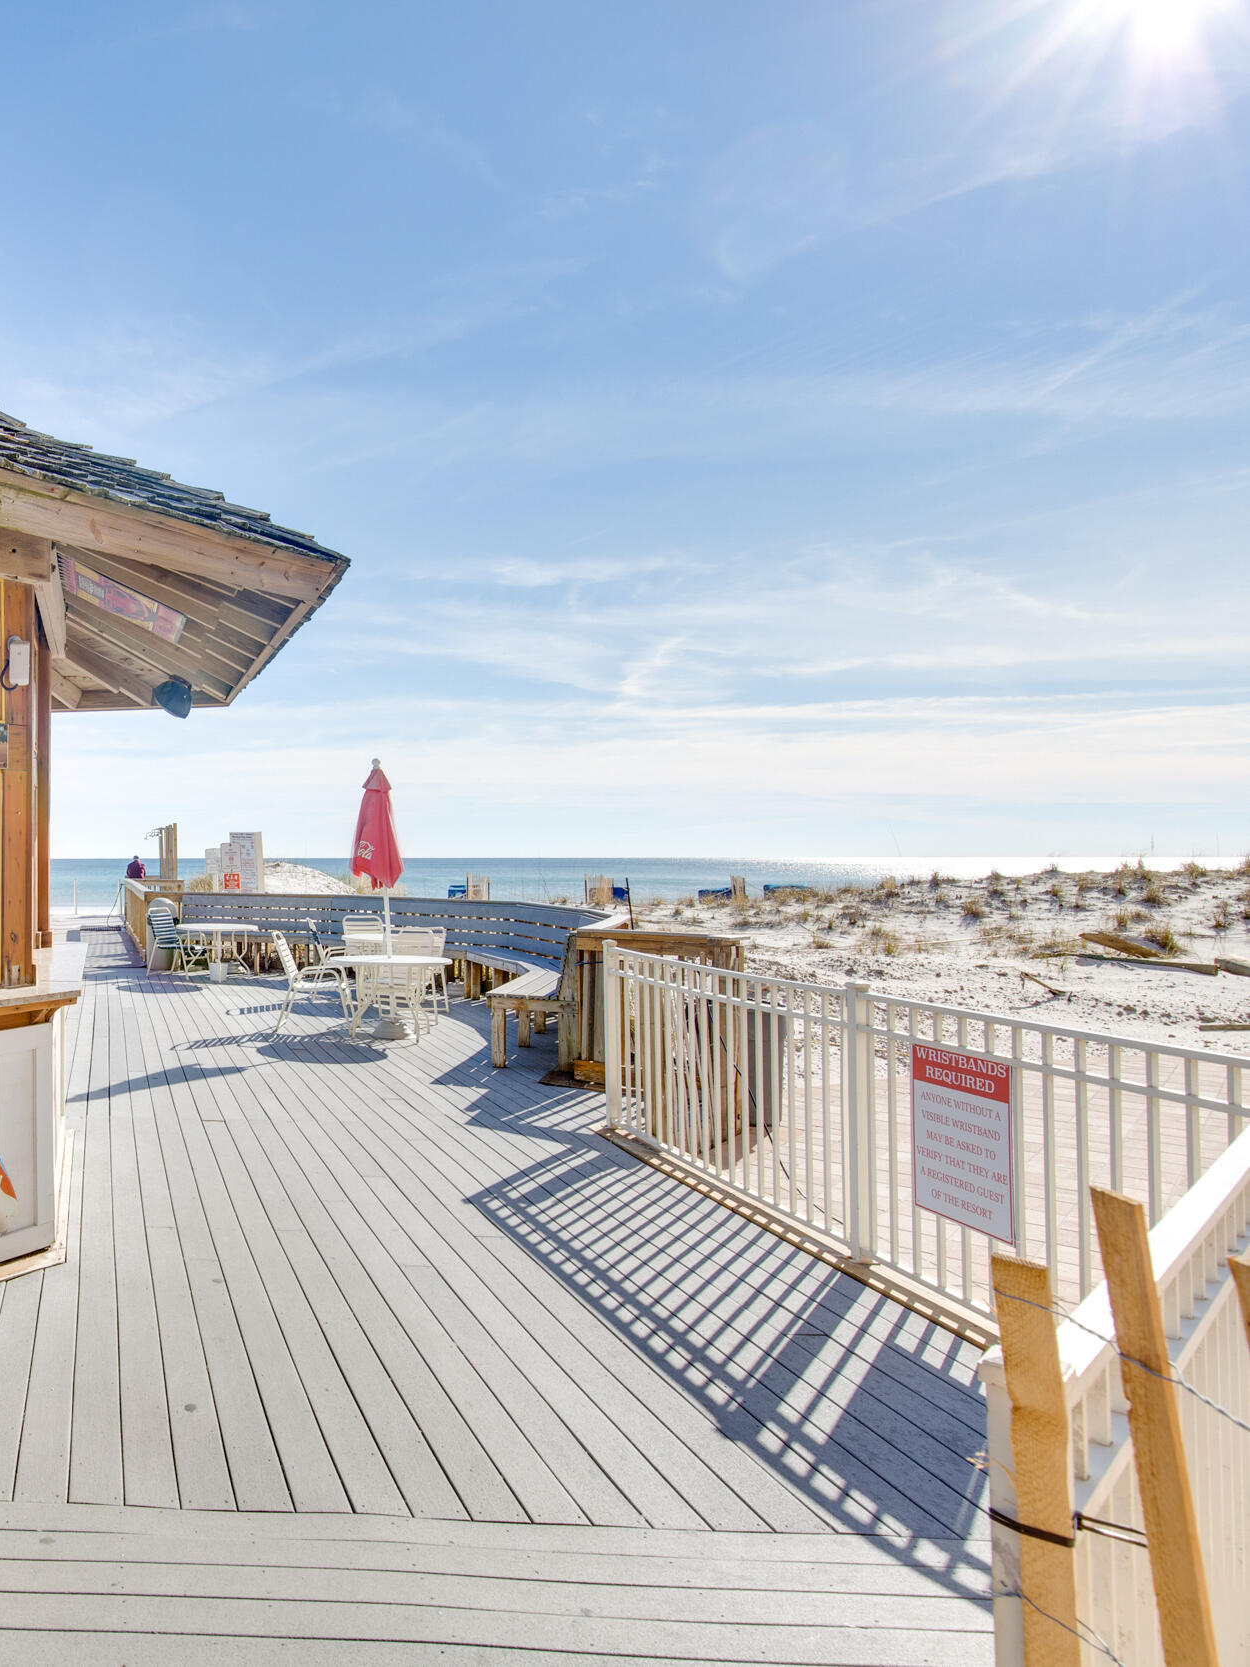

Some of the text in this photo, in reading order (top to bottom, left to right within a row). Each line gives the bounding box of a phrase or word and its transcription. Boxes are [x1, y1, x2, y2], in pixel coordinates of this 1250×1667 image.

[916, 1046, 1008, 1078] WRISTBANDS
[925, 1065, 995, 1094] REQUIRED
[921, 1090, 1002, 1121] ANYONE WITHOUT A
[922, 1110, 1001, 1142] VISIBLE WRISTBAND
[926, 1130, 996, 1161] MAY BE ASKED TO
[917, 1145, 1008, 1185] VERIFY THAT THEY ARE
[920, 1167, 1004, 1205] A REGISTERED GUEST
[931, 1188, 993, 1220] OF THE RESORT
